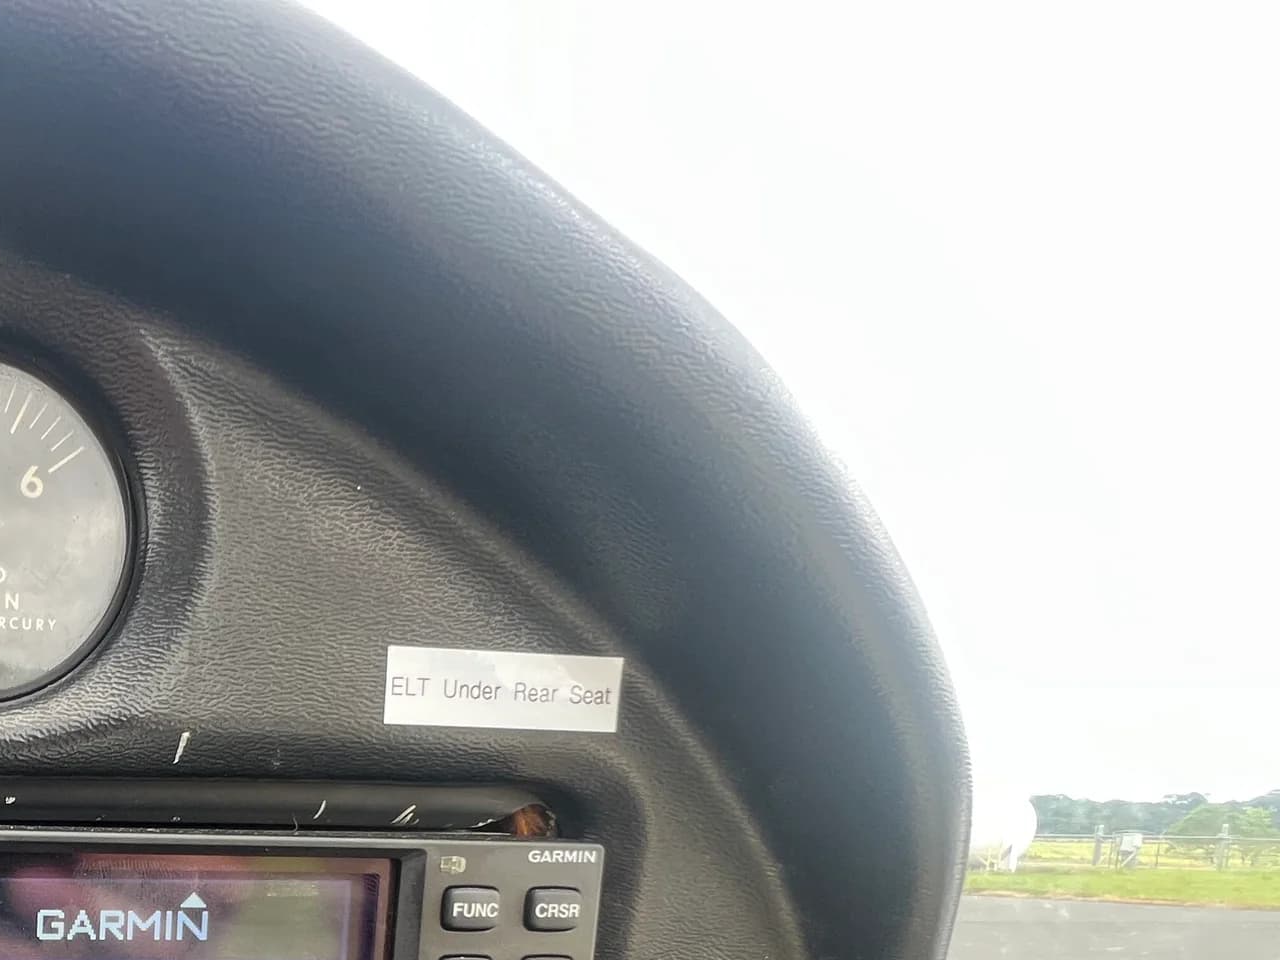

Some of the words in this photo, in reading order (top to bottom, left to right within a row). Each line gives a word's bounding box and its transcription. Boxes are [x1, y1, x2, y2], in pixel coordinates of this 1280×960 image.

[20, 465, 44, 498] 6
[391, 677, 430, 697] ELT
[444, 679, 501, 701] Under
[514, 682, 559, 704] Rear
[569, 684, 611, 706] Seat
[528, 850, 596, 864] GARMIN
[452, 902, 500, 919] FUNC
[535, 903, 580, 918] CRSR
[37, 908, 209, 942] GARMIN
